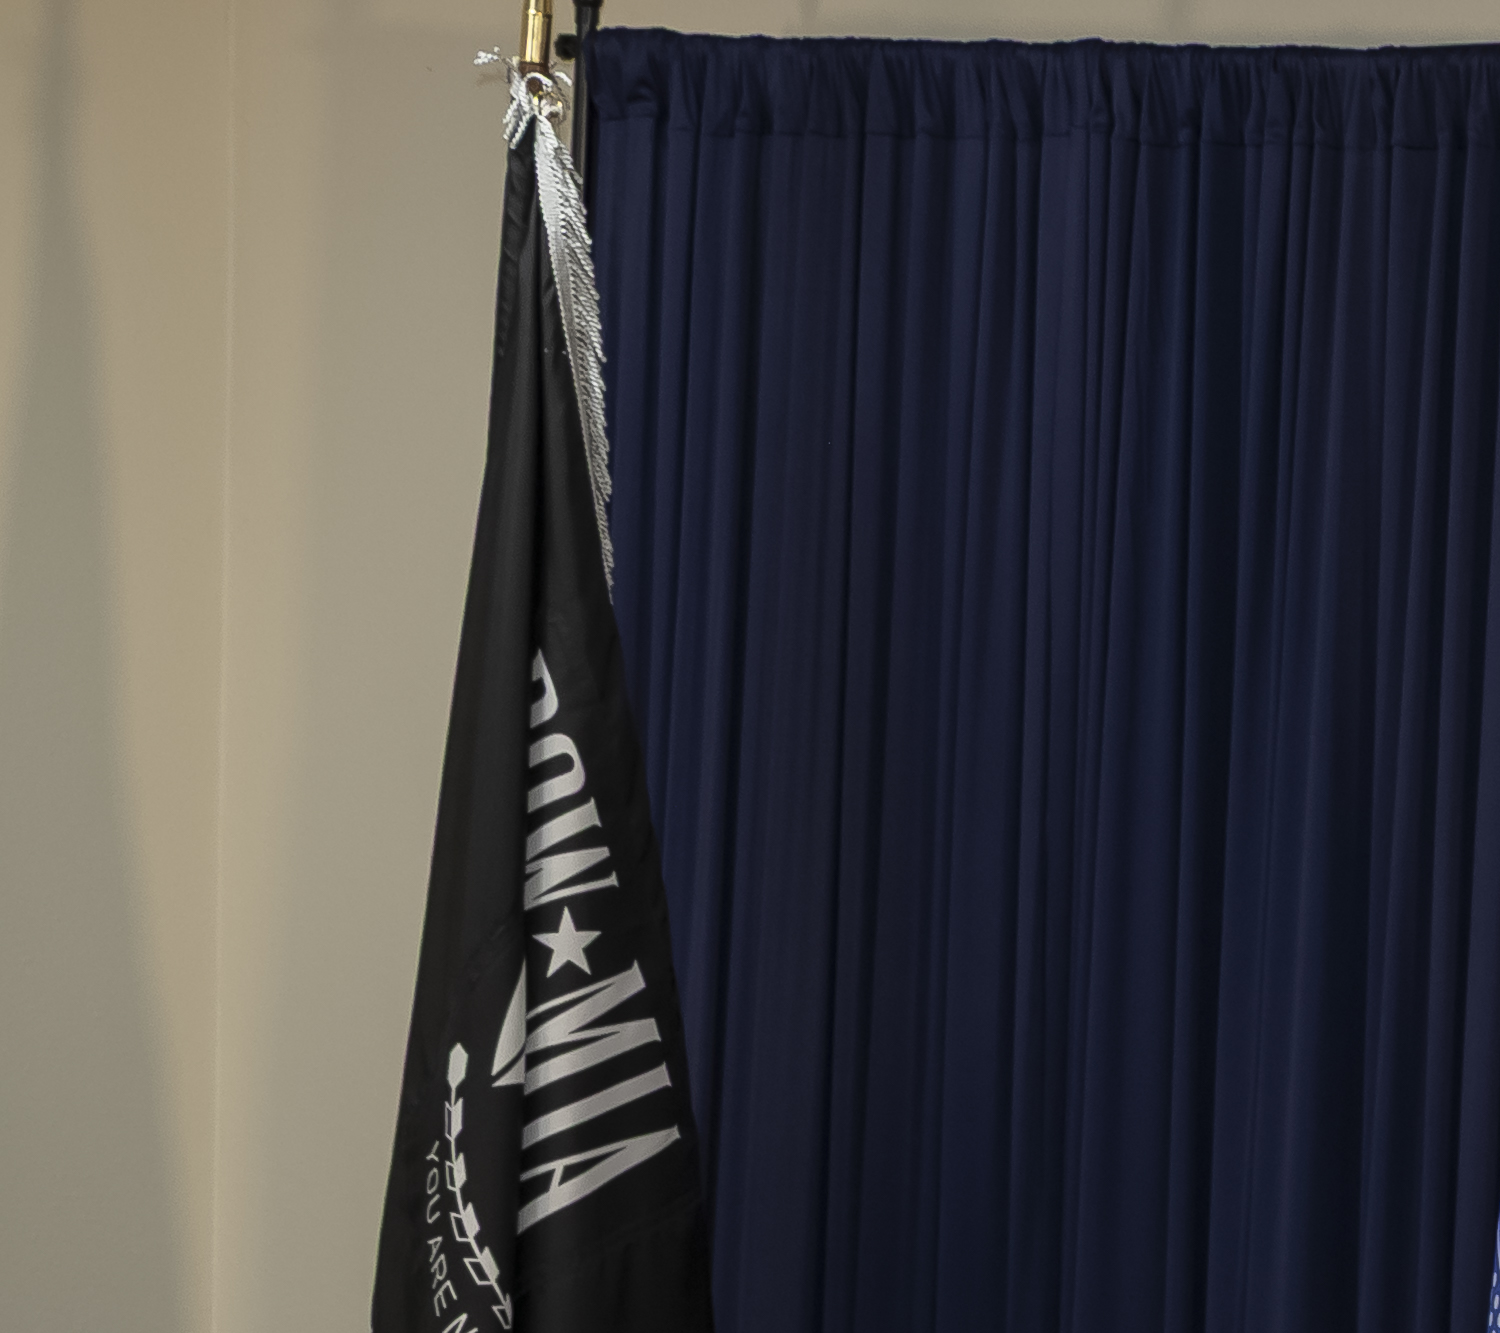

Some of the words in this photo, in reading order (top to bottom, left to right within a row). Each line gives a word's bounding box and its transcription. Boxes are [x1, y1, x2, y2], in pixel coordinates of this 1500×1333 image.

[516, 958, 682, 1236] MIA
[426, 1140, 441, 1224] YOU
[427, 1236, 458, 1318] ARE
